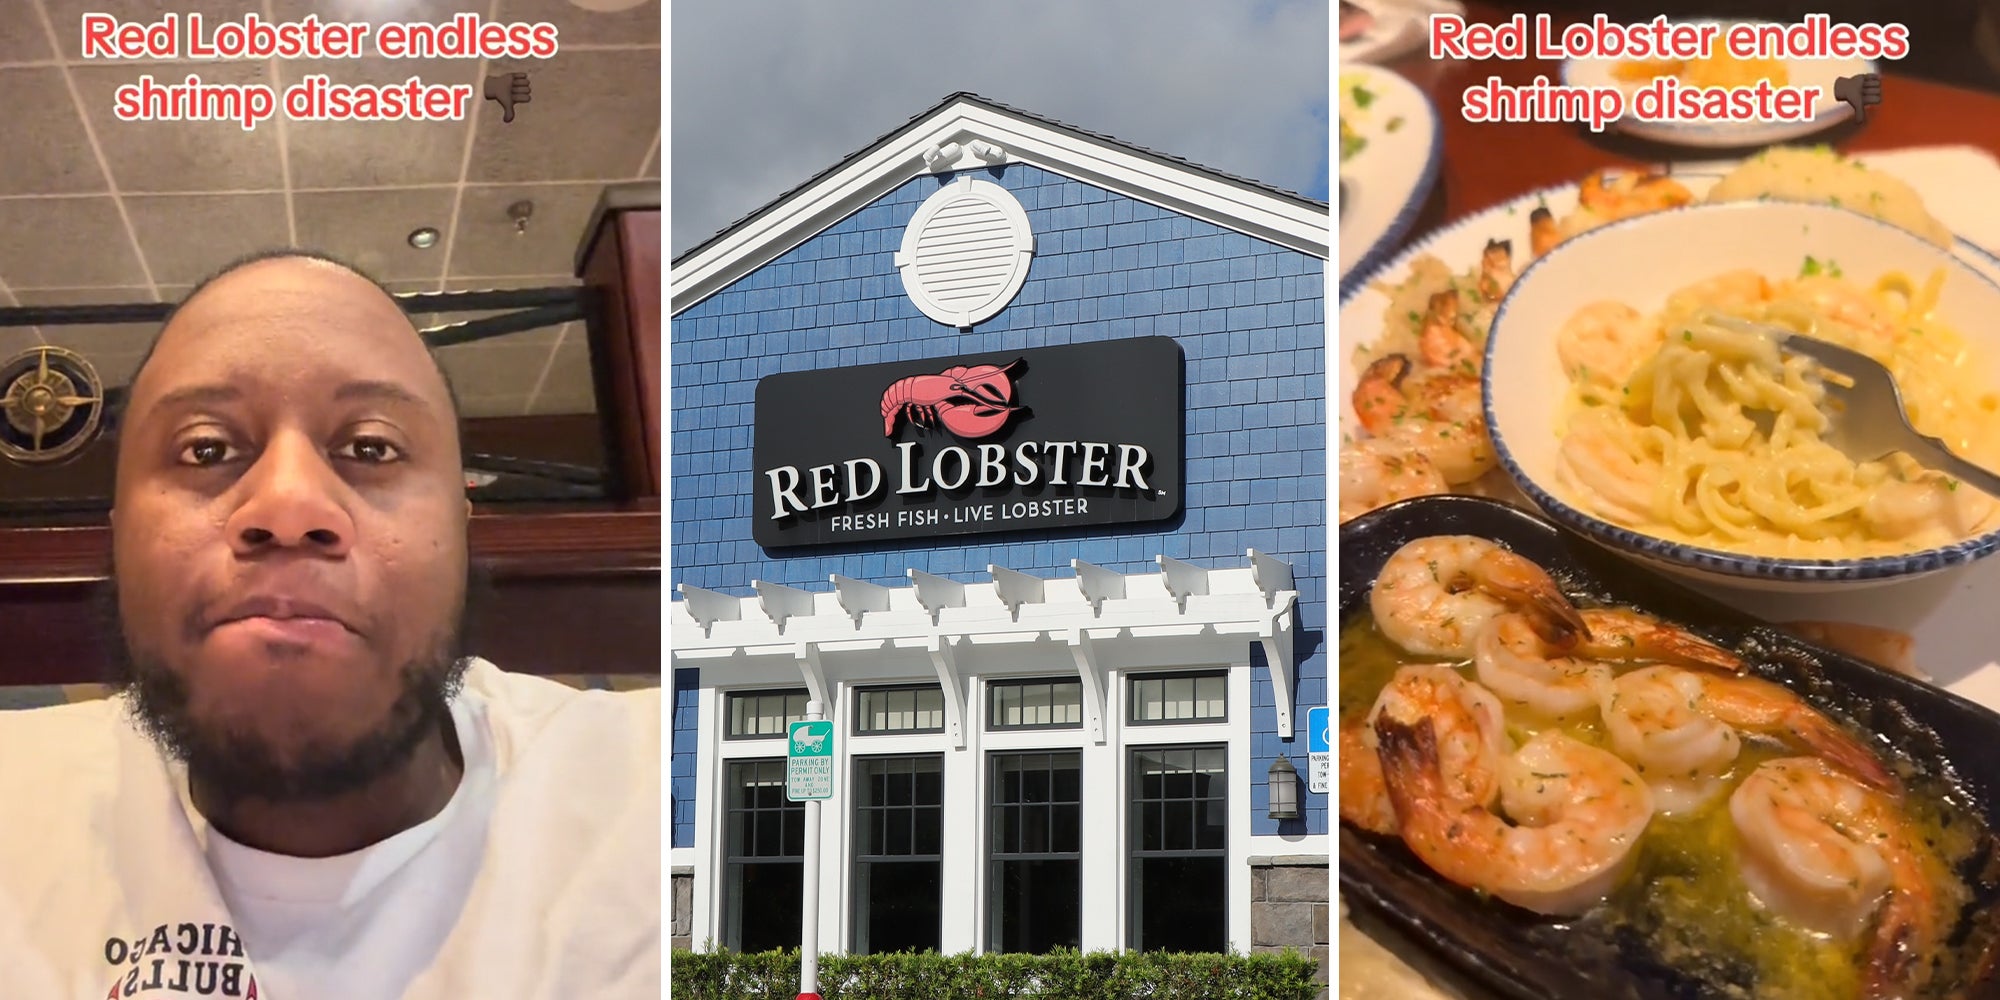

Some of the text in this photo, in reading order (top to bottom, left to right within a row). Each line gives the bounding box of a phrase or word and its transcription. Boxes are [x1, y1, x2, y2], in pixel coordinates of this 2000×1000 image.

[765, 440, 1150, 520] RED LOBSTER
[831, 498, 1089, 532] FRESH FISH LIVE LOBSTER
[791, 766, 830, 775] PERMIT ONLY
[821, 758, 829, 766] BY
